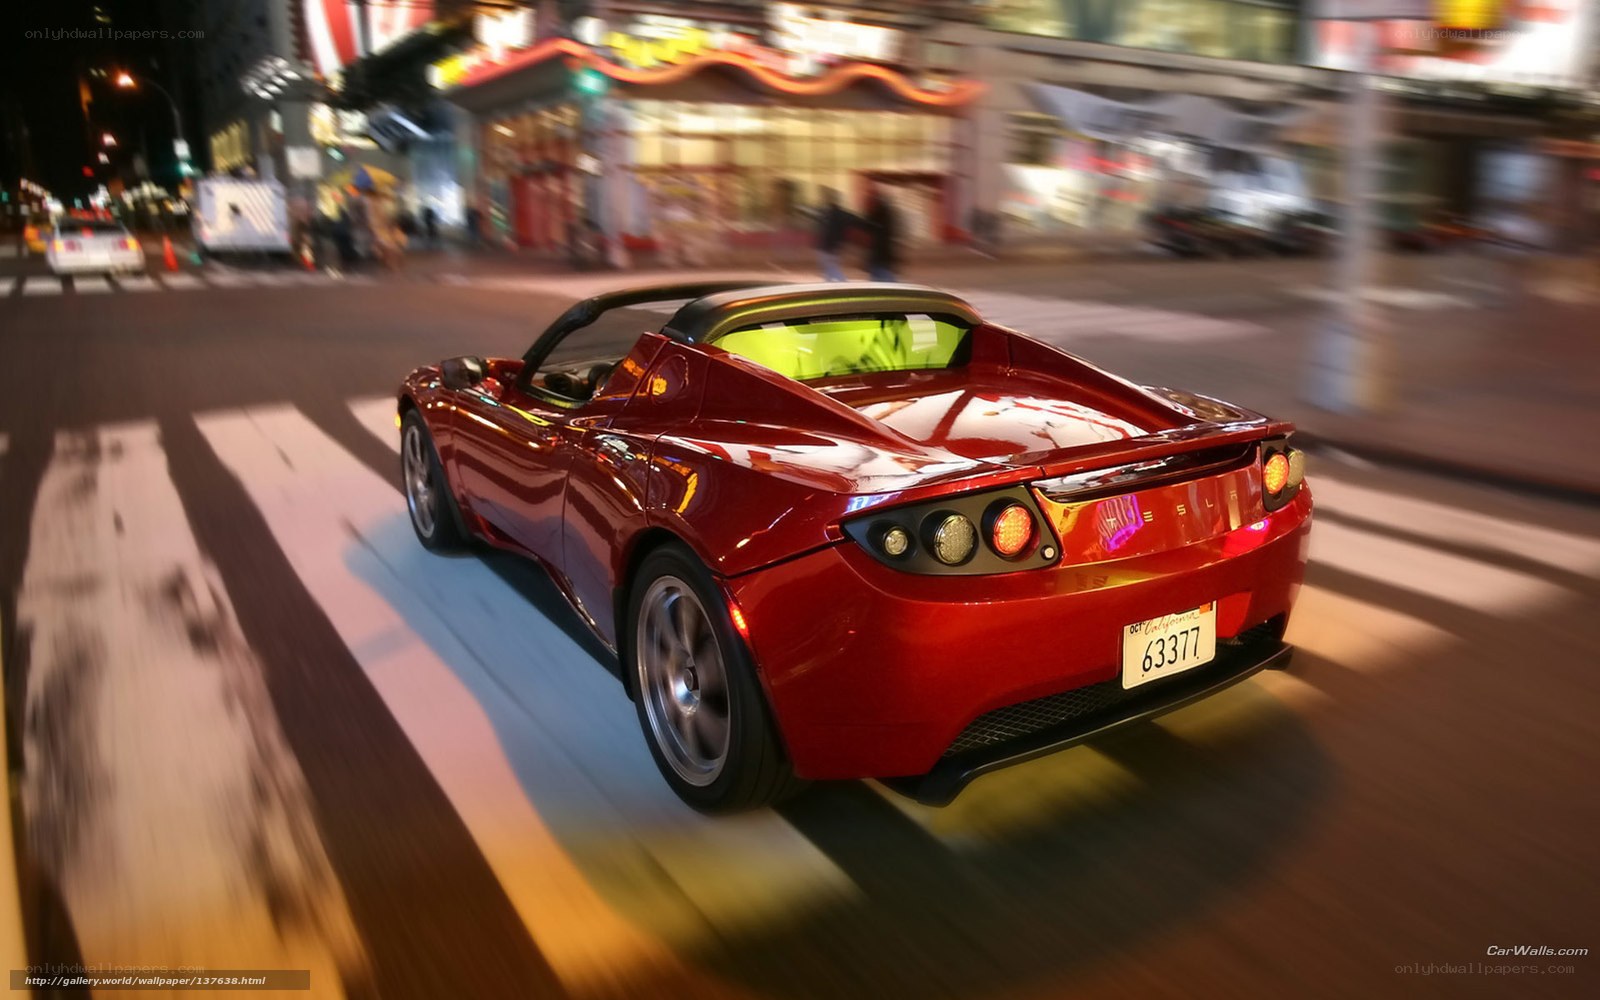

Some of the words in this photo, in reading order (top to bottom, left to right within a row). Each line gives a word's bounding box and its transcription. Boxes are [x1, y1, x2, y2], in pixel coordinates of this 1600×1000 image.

[1106, 489, 1239, 528] TESLA
[1129, 621, 1144, 635] OCT
[1142, 626, 1200, 672] 63377
